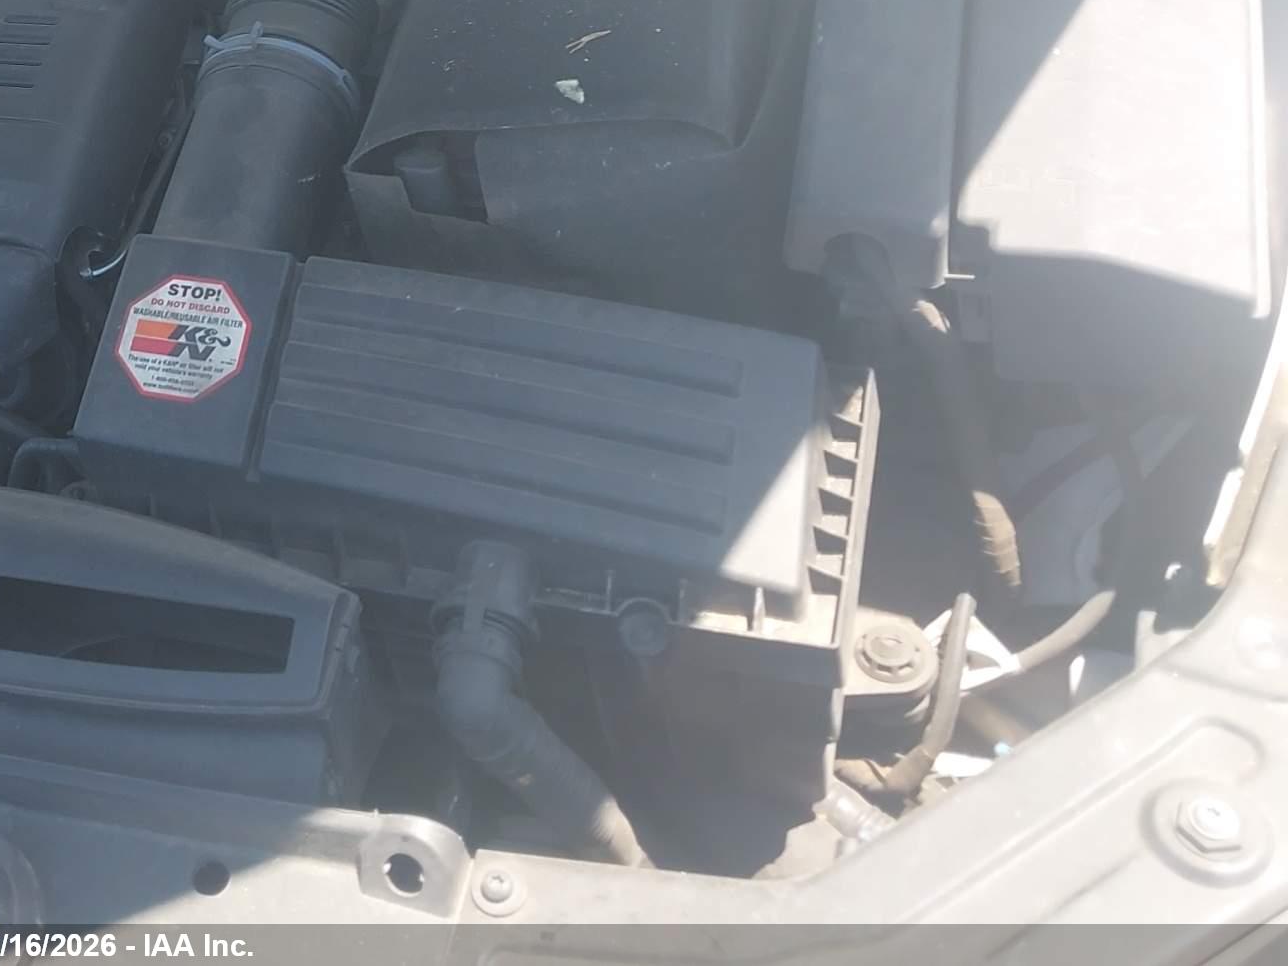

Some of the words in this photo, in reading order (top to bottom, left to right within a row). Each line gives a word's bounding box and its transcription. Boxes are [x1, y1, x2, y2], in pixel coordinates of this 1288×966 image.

[168, 283, 222, 302] STOP!
[151, 297, 164, 306] DO
[166, 300, 187, 309] NOT
[188, 303, 231, 315] DISCARD
[133, 306, 206, 324] WASHABLE/REUSABLE
[207, 316, 219, 325] AIR
[220, 318, 243, 329] FILTER
